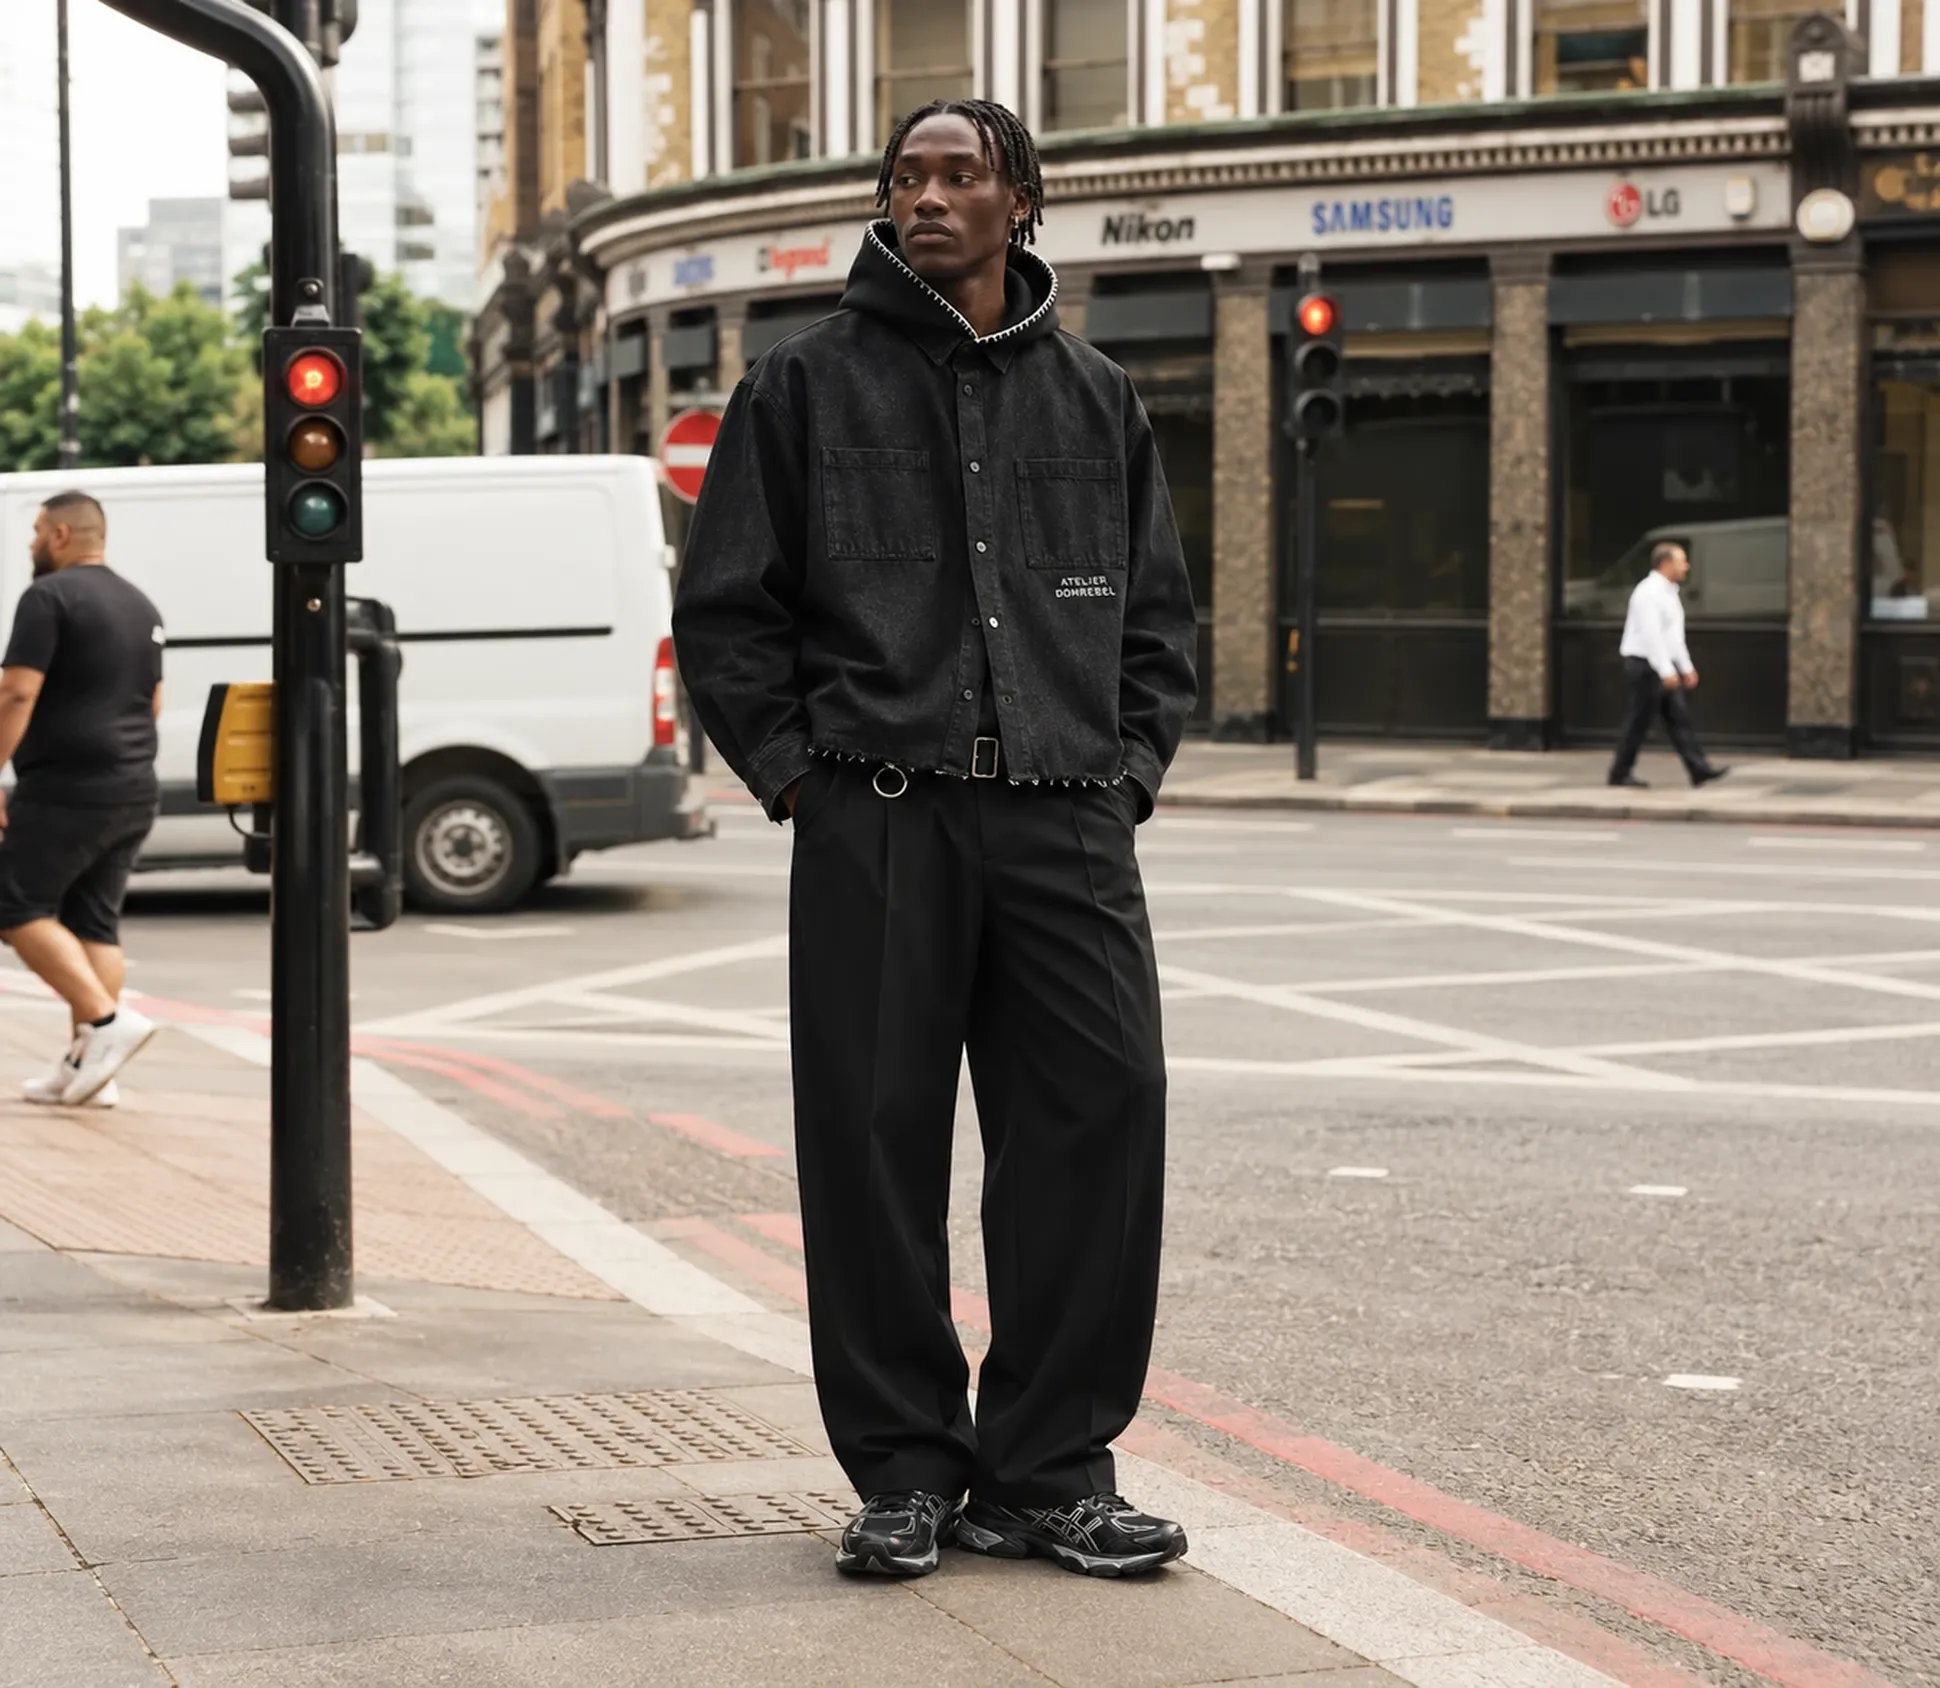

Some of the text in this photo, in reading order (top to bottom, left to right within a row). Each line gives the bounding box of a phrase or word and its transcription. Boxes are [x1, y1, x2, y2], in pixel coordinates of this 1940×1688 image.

[1312, 195, 1453, 234] SAMSUNG
[1647, 188, 1681, 218] LG
[1101, 213, 1195, 246] Nikon
[1061, 575, 1107, 586] ATELIER
